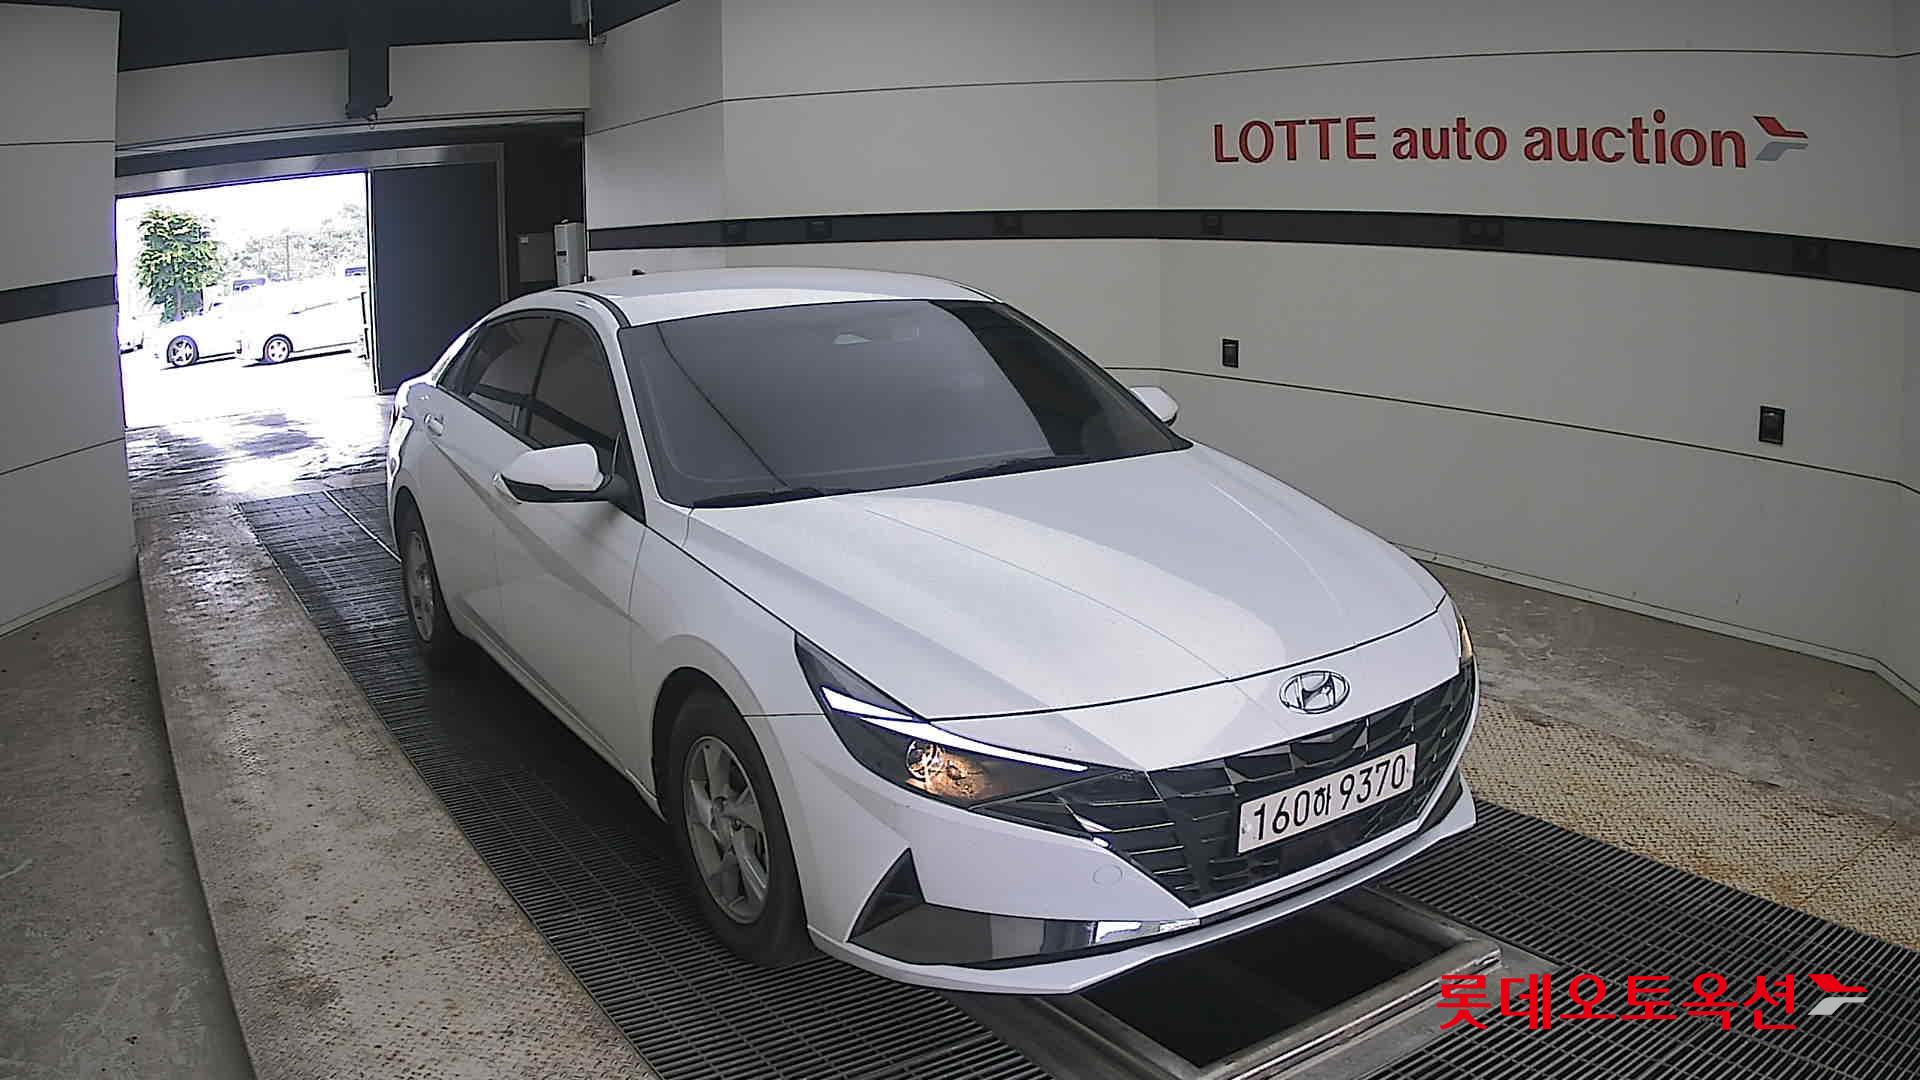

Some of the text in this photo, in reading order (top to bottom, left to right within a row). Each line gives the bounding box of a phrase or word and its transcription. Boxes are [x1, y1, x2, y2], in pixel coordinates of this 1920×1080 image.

[1213, 109, 1746, 168] LOTTE auto auction
[1254, 754, 1406, 841] 160하 9370
